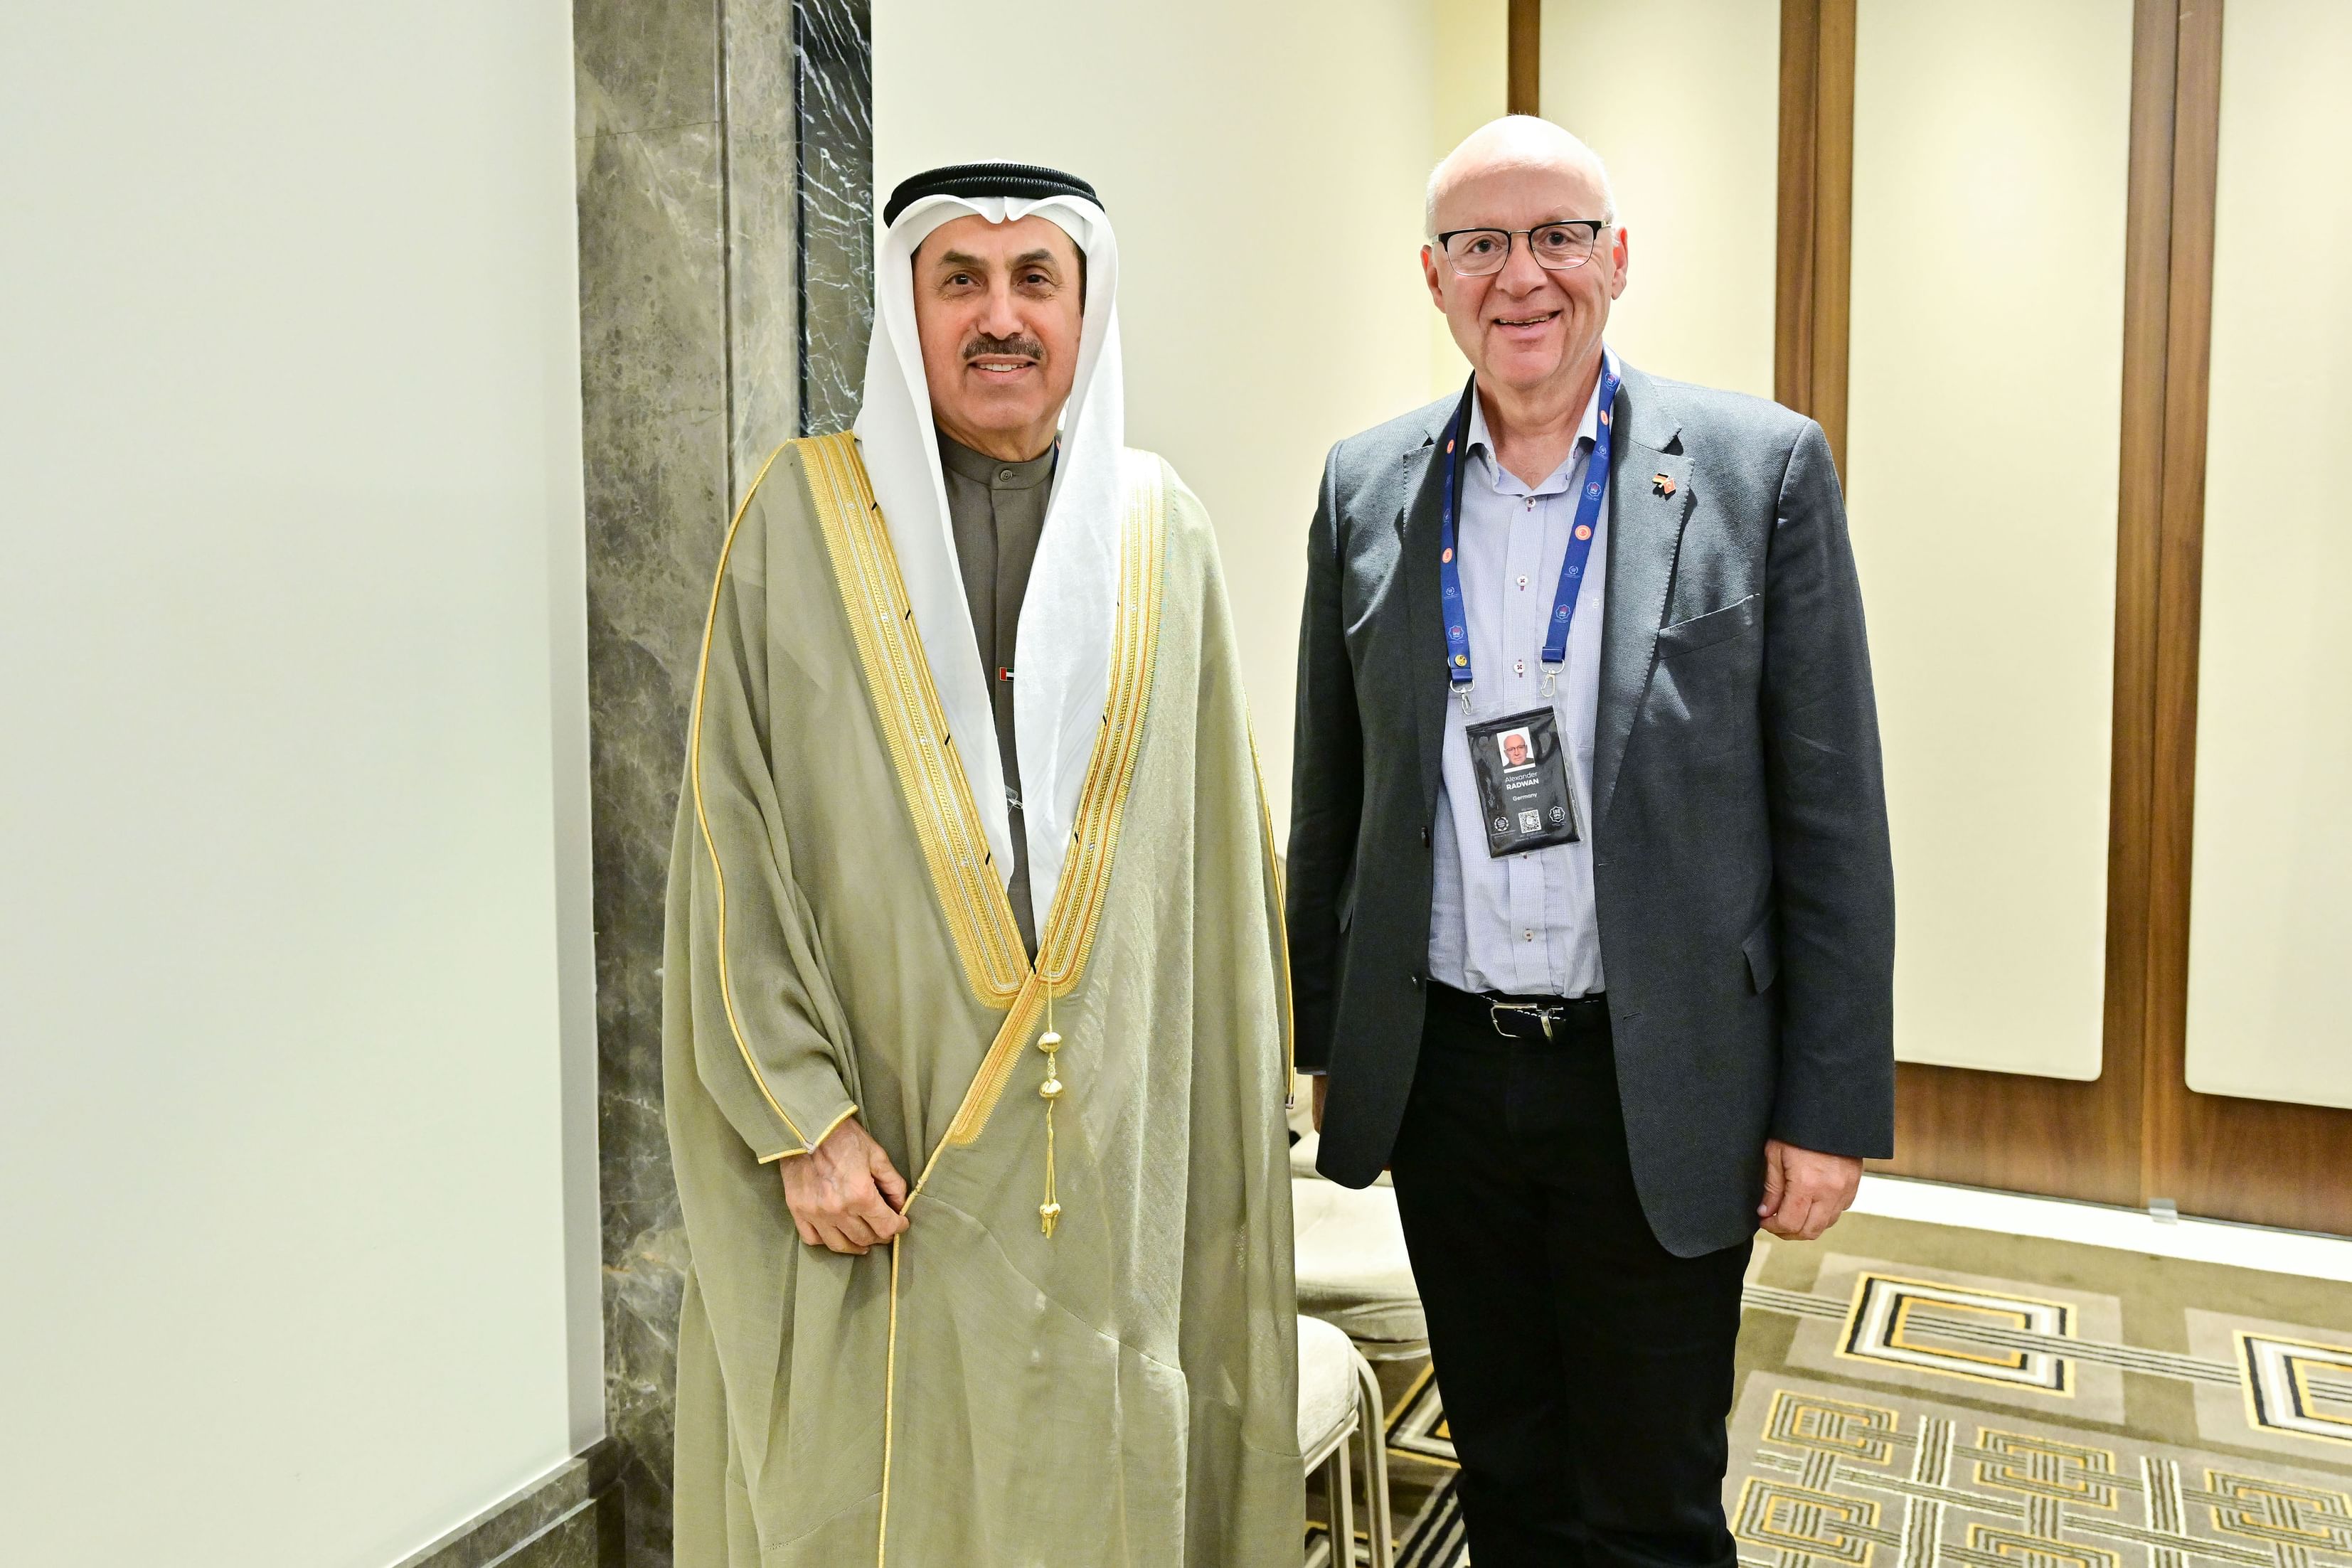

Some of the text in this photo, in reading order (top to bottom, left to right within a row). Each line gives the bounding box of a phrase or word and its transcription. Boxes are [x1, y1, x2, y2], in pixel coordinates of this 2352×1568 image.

[1505, 772, 1538, 783] Alexander
[1506, 779, 1539, 790] RADWAN
[1513, 792, 1538, 801] Germany
